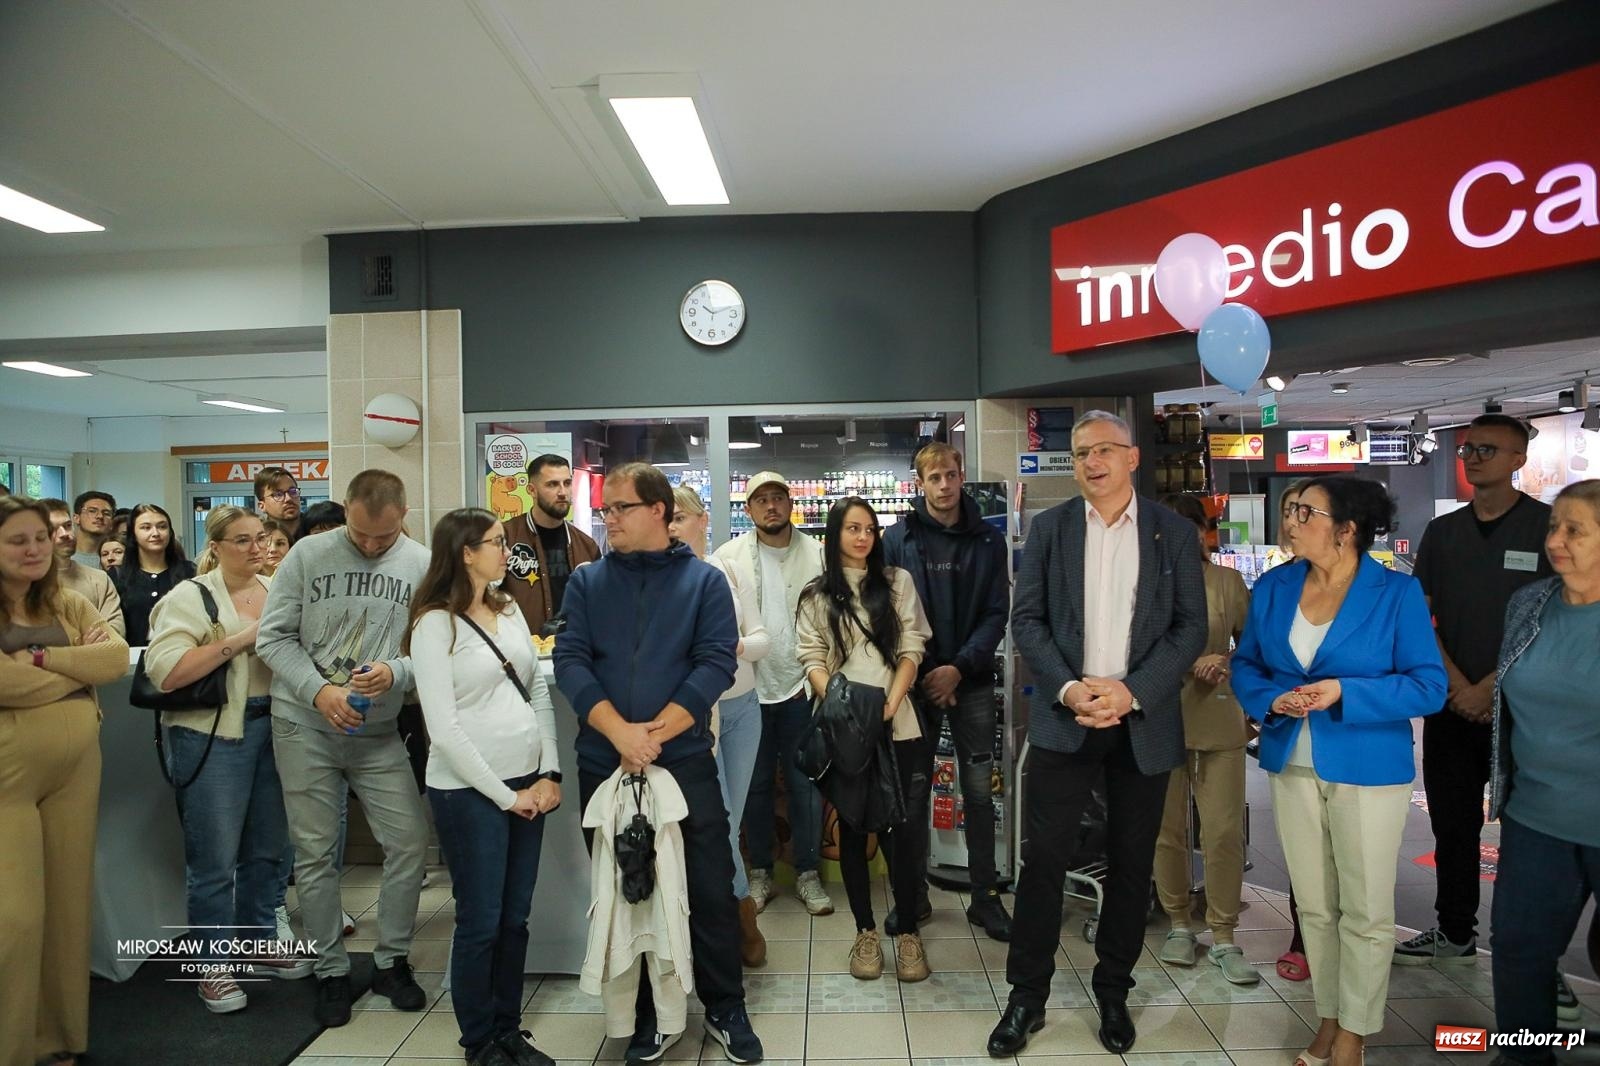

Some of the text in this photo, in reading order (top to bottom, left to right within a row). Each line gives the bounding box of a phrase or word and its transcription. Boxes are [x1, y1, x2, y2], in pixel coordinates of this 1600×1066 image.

[1448, 161, 1600, 248] Ca
[688, 308, 696, 317] 9
[729, 310, 738, 318] 3
[708, 329, 716, 338] 6
[492, 445, 511, 453] BACK
[310, 571, 411, 607] ST. THOMA
